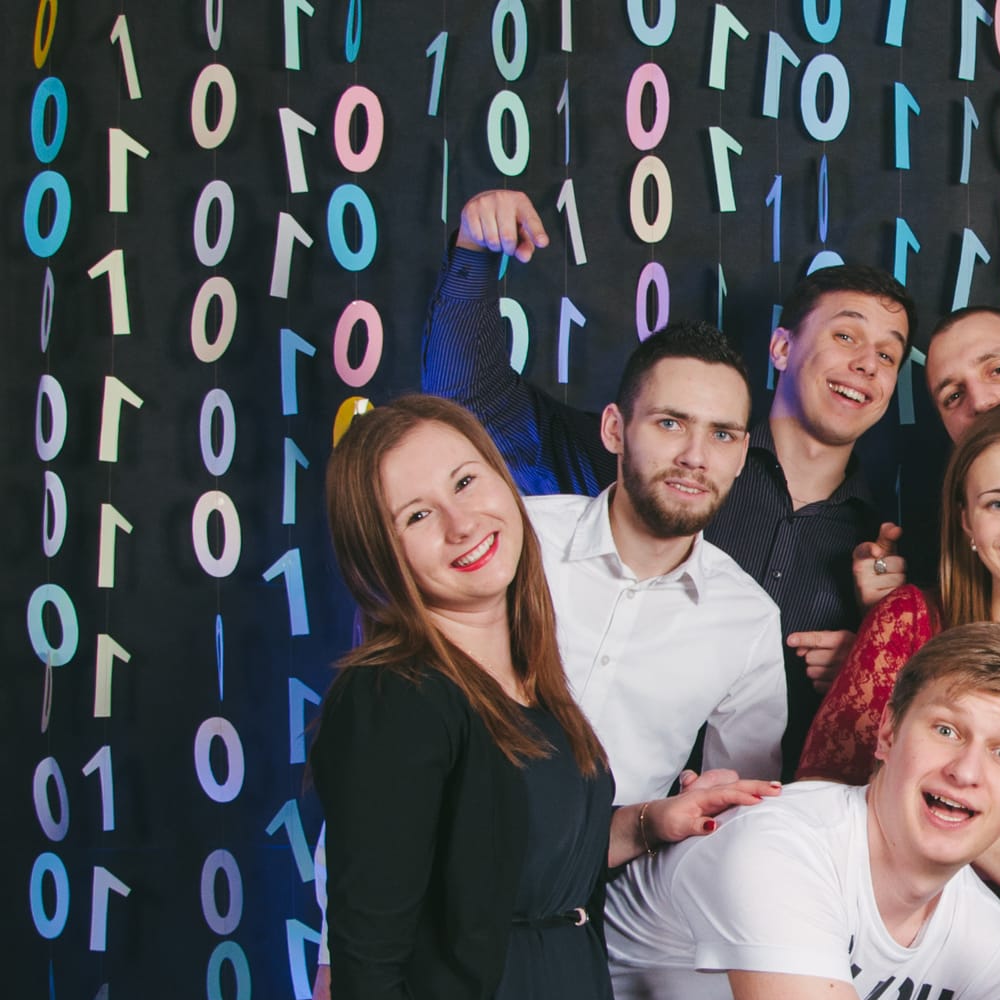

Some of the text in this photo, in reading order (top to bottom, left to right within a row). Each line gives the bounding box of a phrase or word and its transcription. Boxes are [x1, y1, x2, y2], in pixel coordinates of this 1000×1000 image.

[34, 0, 57, 68] 0
[110, 15, 141, 99] 1
[345, 0, 361, 62] 0
[426, 32, 448, 116] 1
[492, 0, 527, 80] 0
[30, 77, 67, 163] 0
[191, 64, 236, 149] 0
[334, 85, 383, 172] 0
[487, 90, 529, 176] 0
[626, 63, 669, 150] 0
[801, 53, 849, 141] 0
[23, 170, 71, 257] 0
[193, 180, 234, 266] 0
[327, 184, 377, 271] 0
[557, 179, 587, 265] 1
[630, 156, 672, 243] 0
[766, 175, 782, 262] 1
[88, 249, 130, 335] 1
[191, 277, 237, 362] 0
[636, 262, 669, 342] 0
[334, 300, 383, 387] 0
[36, 375, 67, 461] 0
[200, 389, 235, 476] 0
[192, 491, 241, 577] 0
[27, 584, 78, 669] 0
[262, 548, 309, 636] 1
[33, 757, 69, 841] 0
[82, 746, 114, 831] 1
[194, 717, 244, 803] 0
[265, 799, 315, 883] 1
[30, 852, 69, 939] 0
[201, 849, 243, 935] 0
